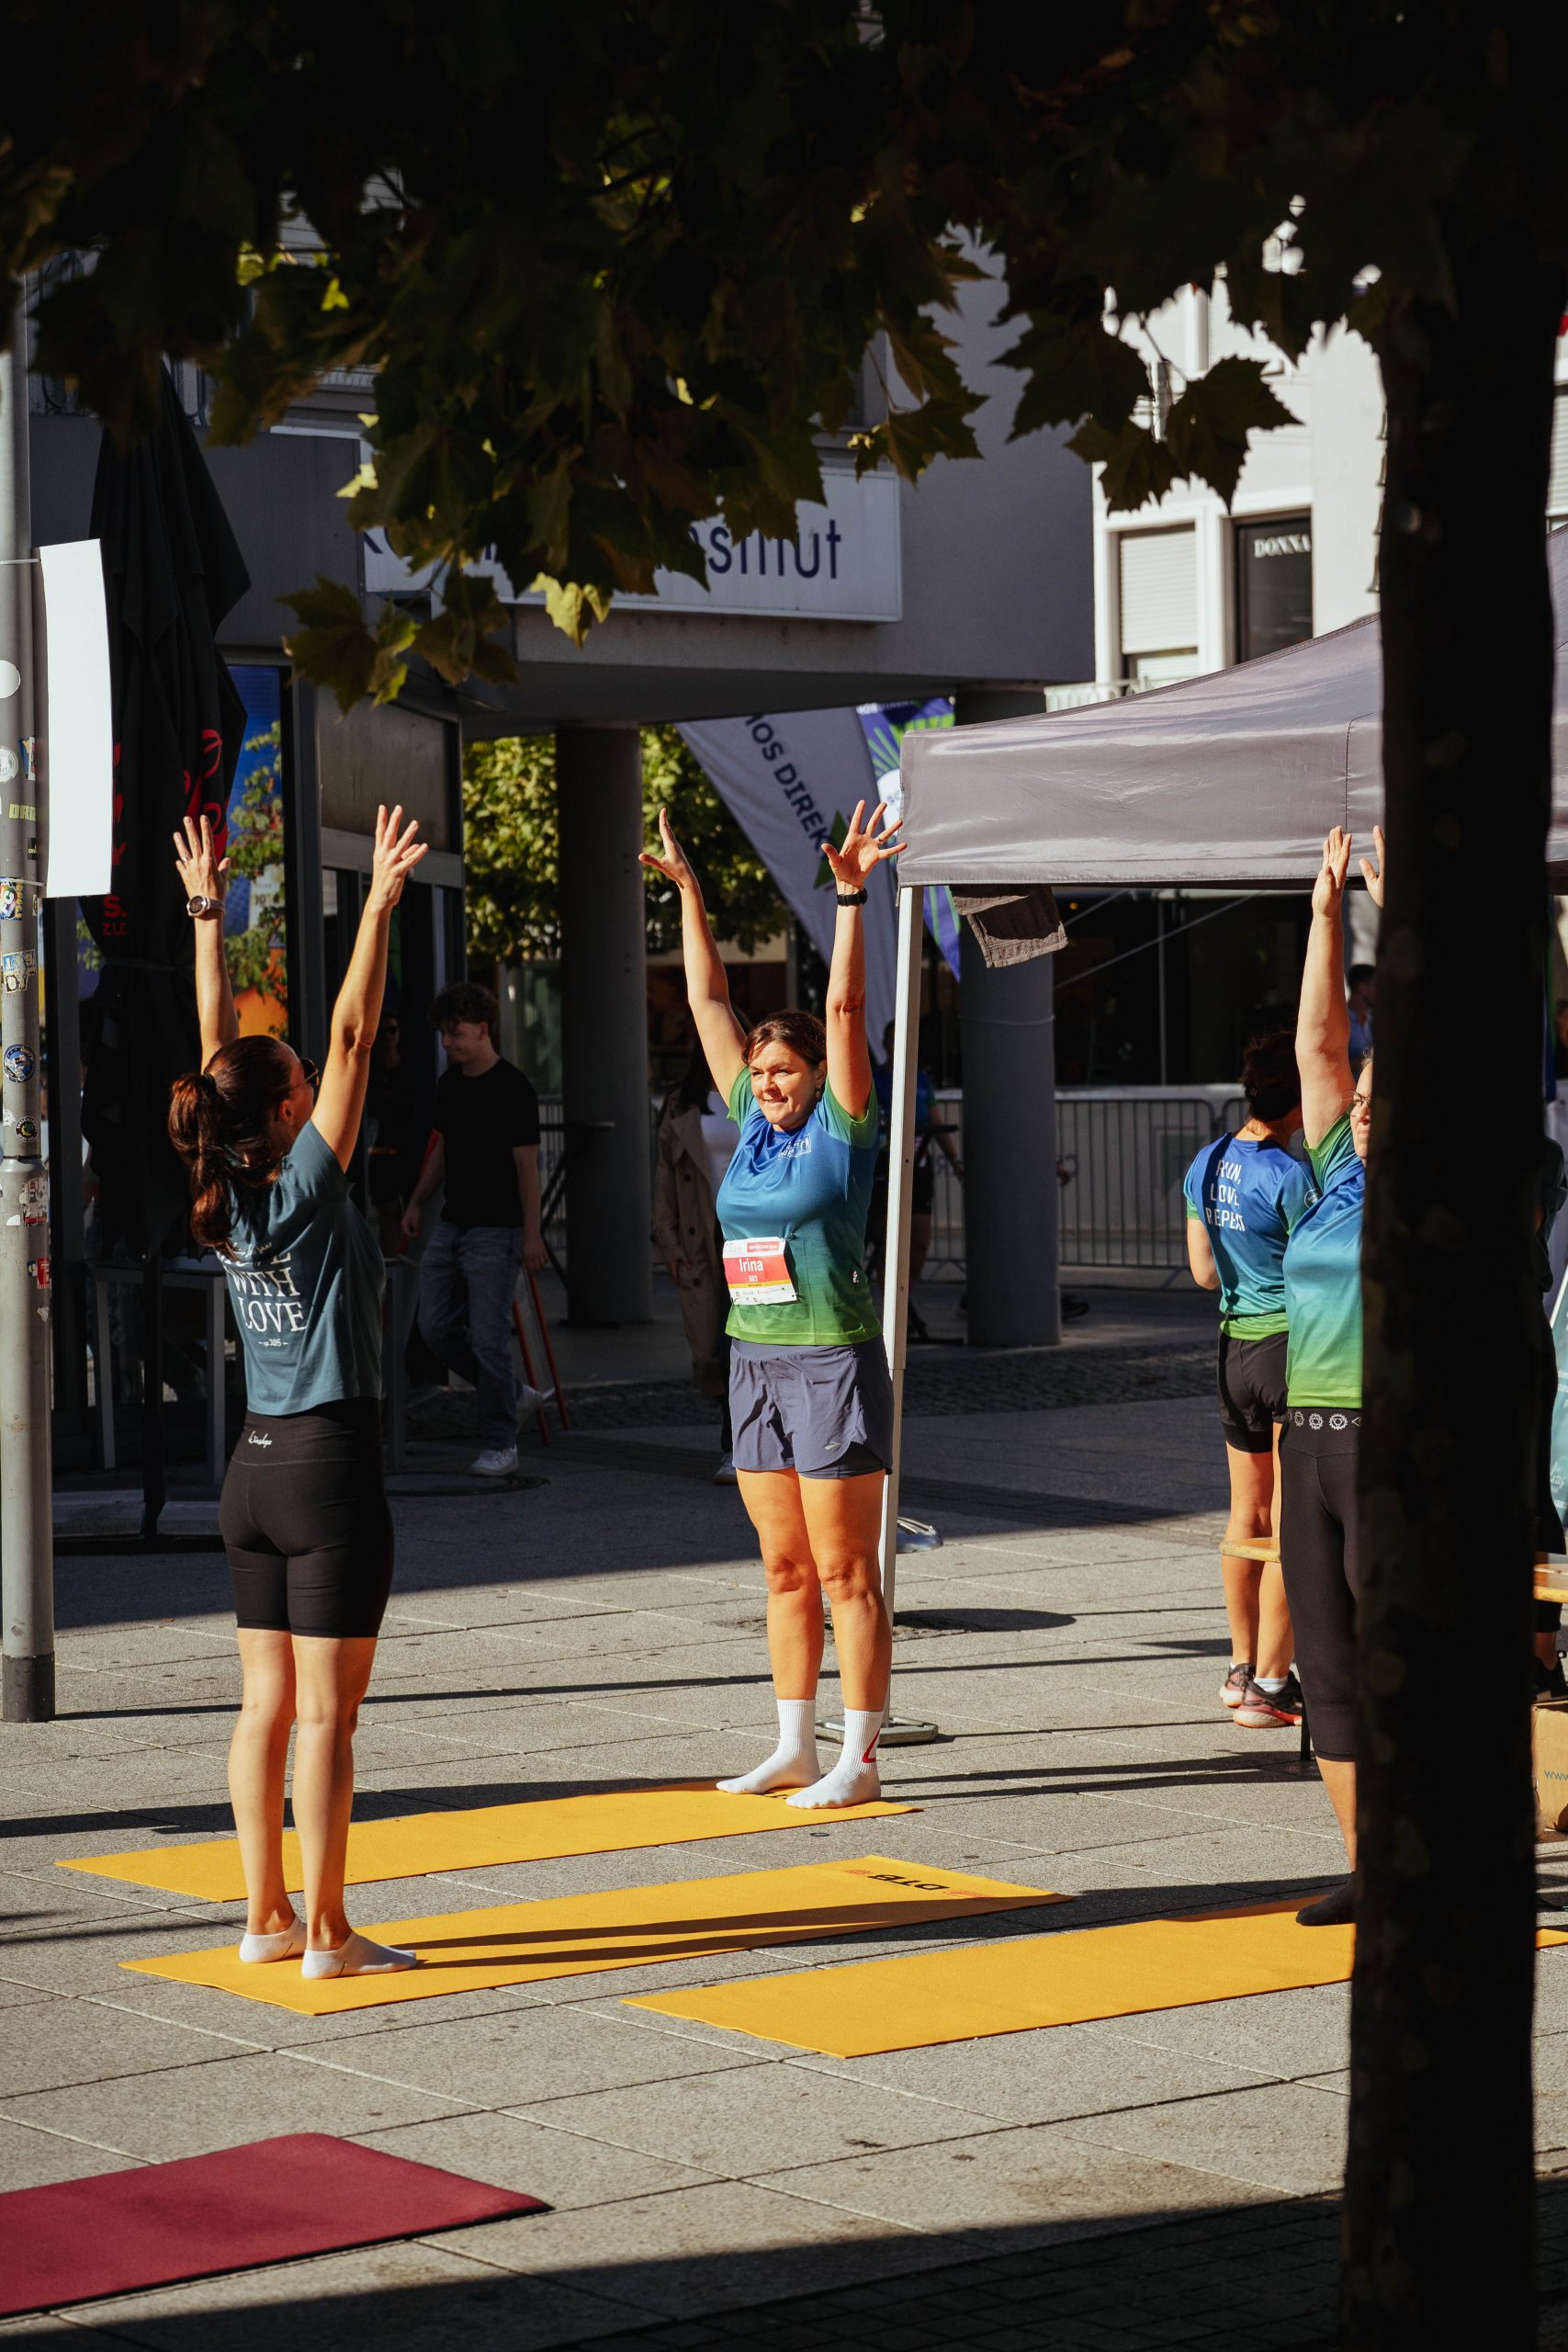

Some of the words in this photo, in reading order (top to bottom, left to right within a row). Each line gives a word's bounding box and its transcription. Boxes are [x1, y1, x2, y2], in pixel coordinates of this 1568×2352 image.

[773, 763, 832, 854] DIREK
[223, 1264, 301, 1297] WITH
[739, 1258, 763, 1272] Irina
[237, 1295, 309, 1333] LOVE
[866, 1873, 951, 1891] DTB
